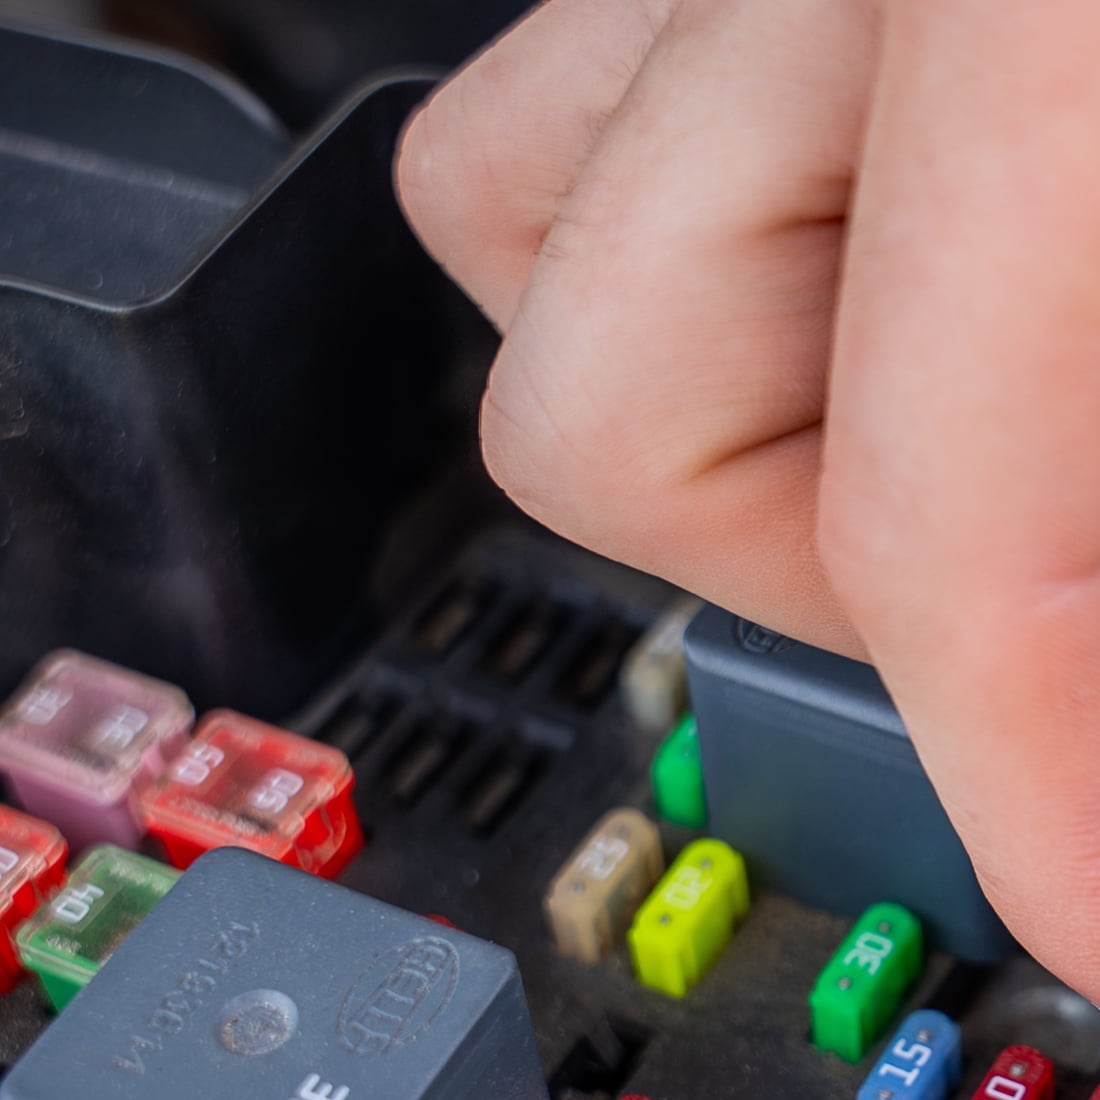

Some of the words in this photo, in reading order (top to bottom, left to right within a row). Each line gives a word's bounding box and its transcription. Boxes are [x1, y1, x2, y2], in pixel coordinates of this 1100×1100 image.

[53, 883, 104, 924] 40
[843, 931, 892, 976] 30
[879, 1038, 933, 1086] 15
